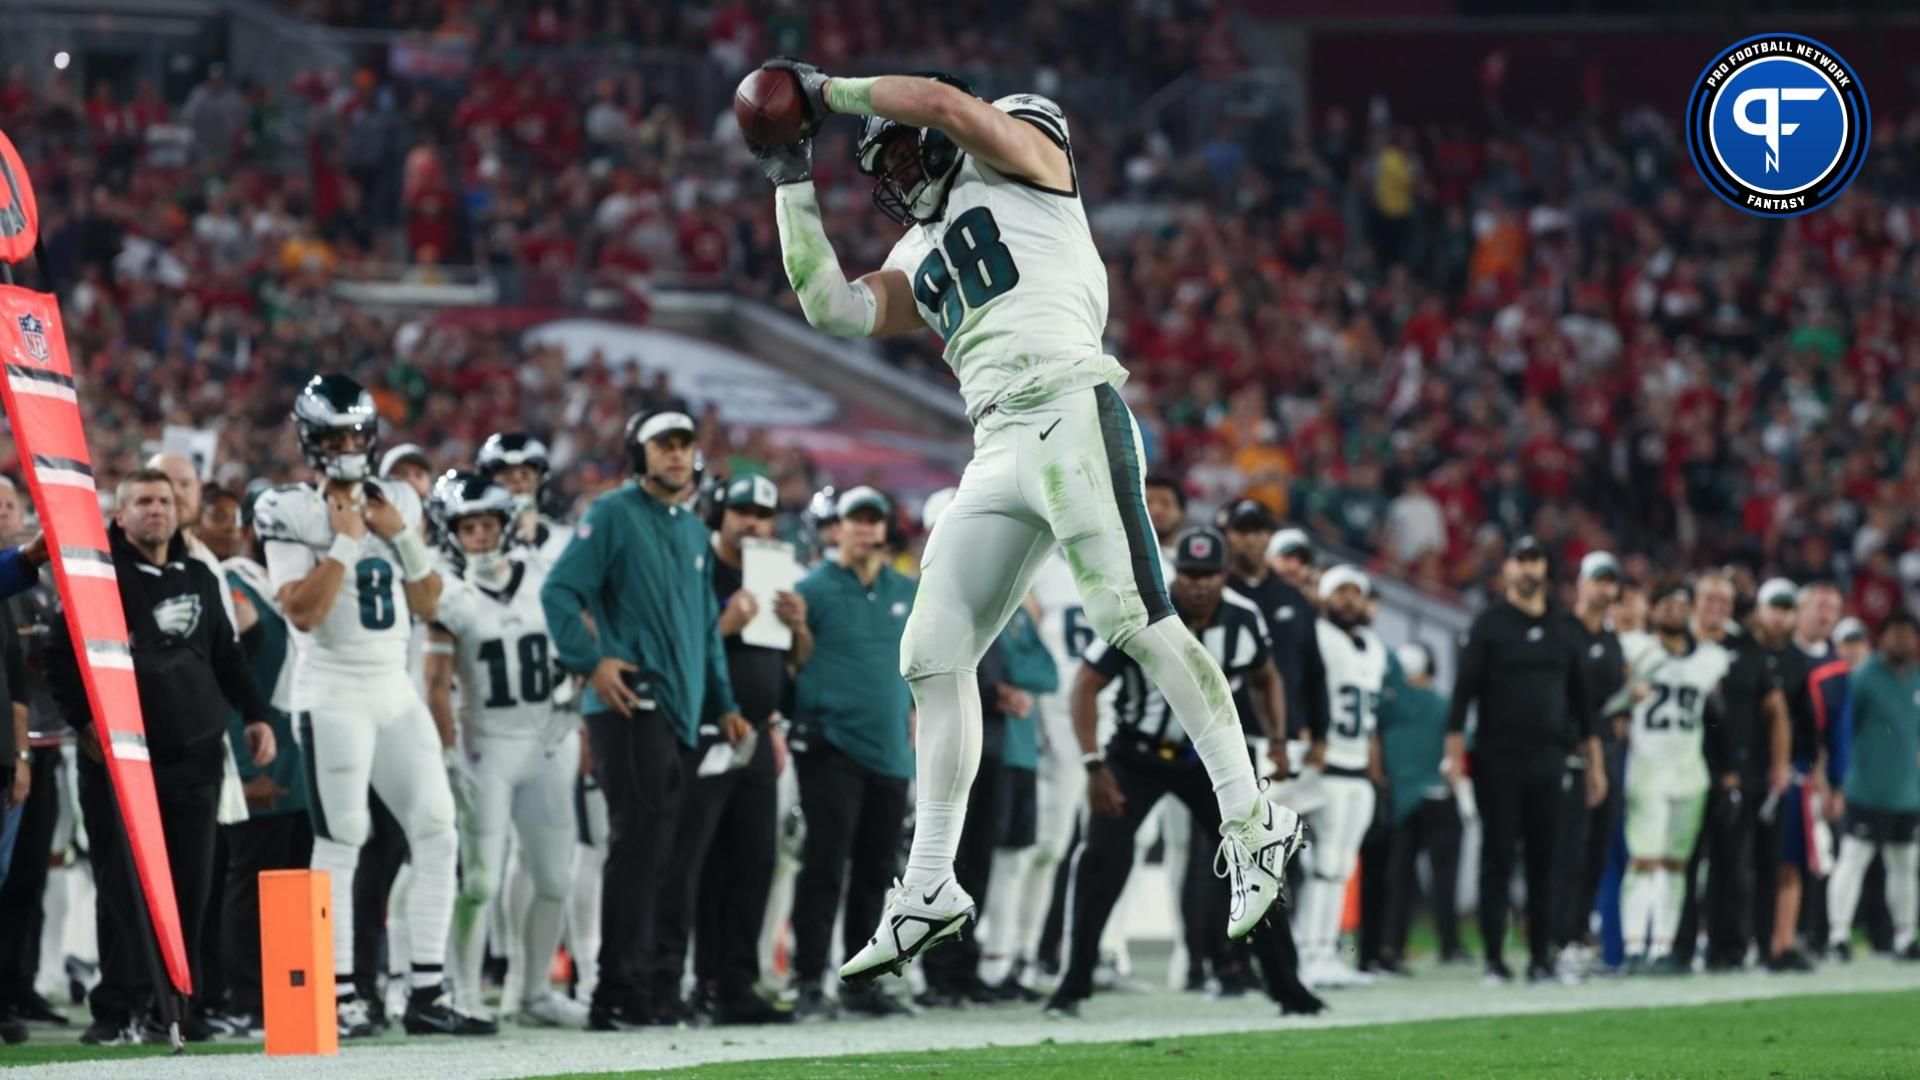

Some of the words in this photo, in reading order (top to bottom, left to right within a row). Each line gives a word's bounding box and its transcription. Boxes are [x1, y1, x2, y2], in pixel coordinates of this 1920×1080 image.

[914, 206, 1020, 342] 88
[356, 557, 395, 630] 8
[478, 633, 550, 708] 18
